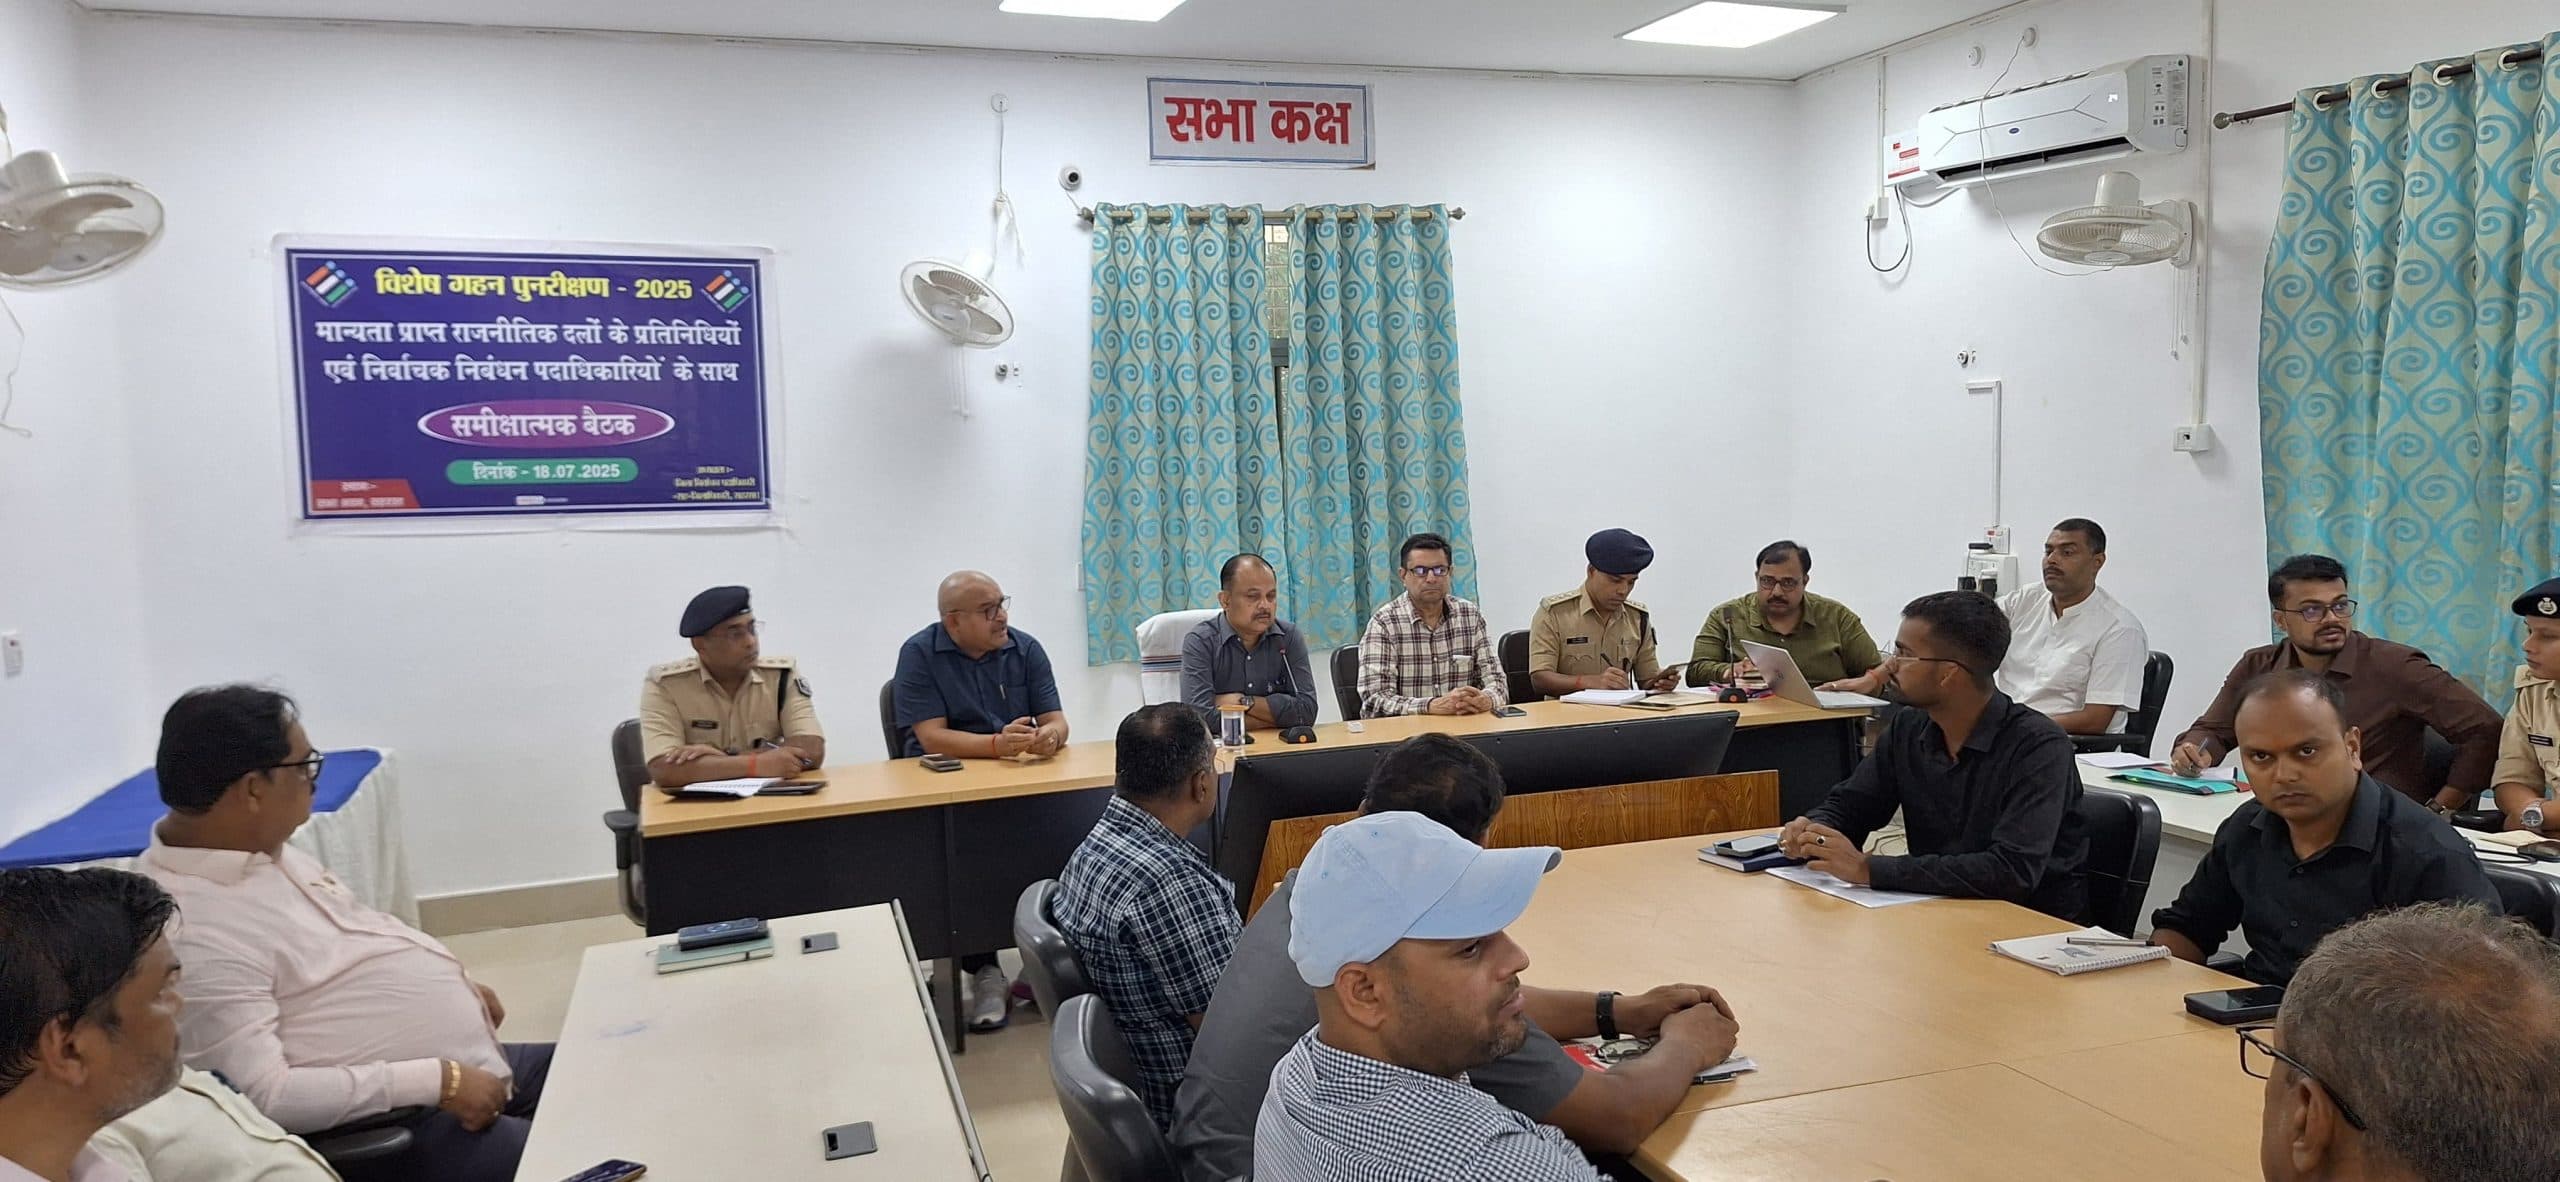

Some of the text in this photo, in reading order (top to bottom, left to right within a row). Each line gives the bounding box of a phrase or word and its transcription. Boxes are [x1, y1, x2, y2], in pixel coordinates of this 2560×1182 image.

[1163, 96, 1352, 145] सभा कक्ष
[374, 266, 442, 296] विशेष
[447, 273, 505, 296] गहन
[511, 270, 610, 302] पुनरीक्षण
[634, 278, 693, 299] 2025
[315, 316, 741, 346] मान्यता प्राप्त राजनीतिक दलों के प्रतिनिधियों
[323, 353, 357, 384] एवं
[362, 352, 450, 381] निर्वाचक
[455, 353, 529, 381] निबंधन
[673, 355, 693, 381] के
[699, 362, 739, 382] साथ
[450, 405, 636, 437] समीक्षात्मक बैठक
[472, 461, 518, 480] दिनांक
